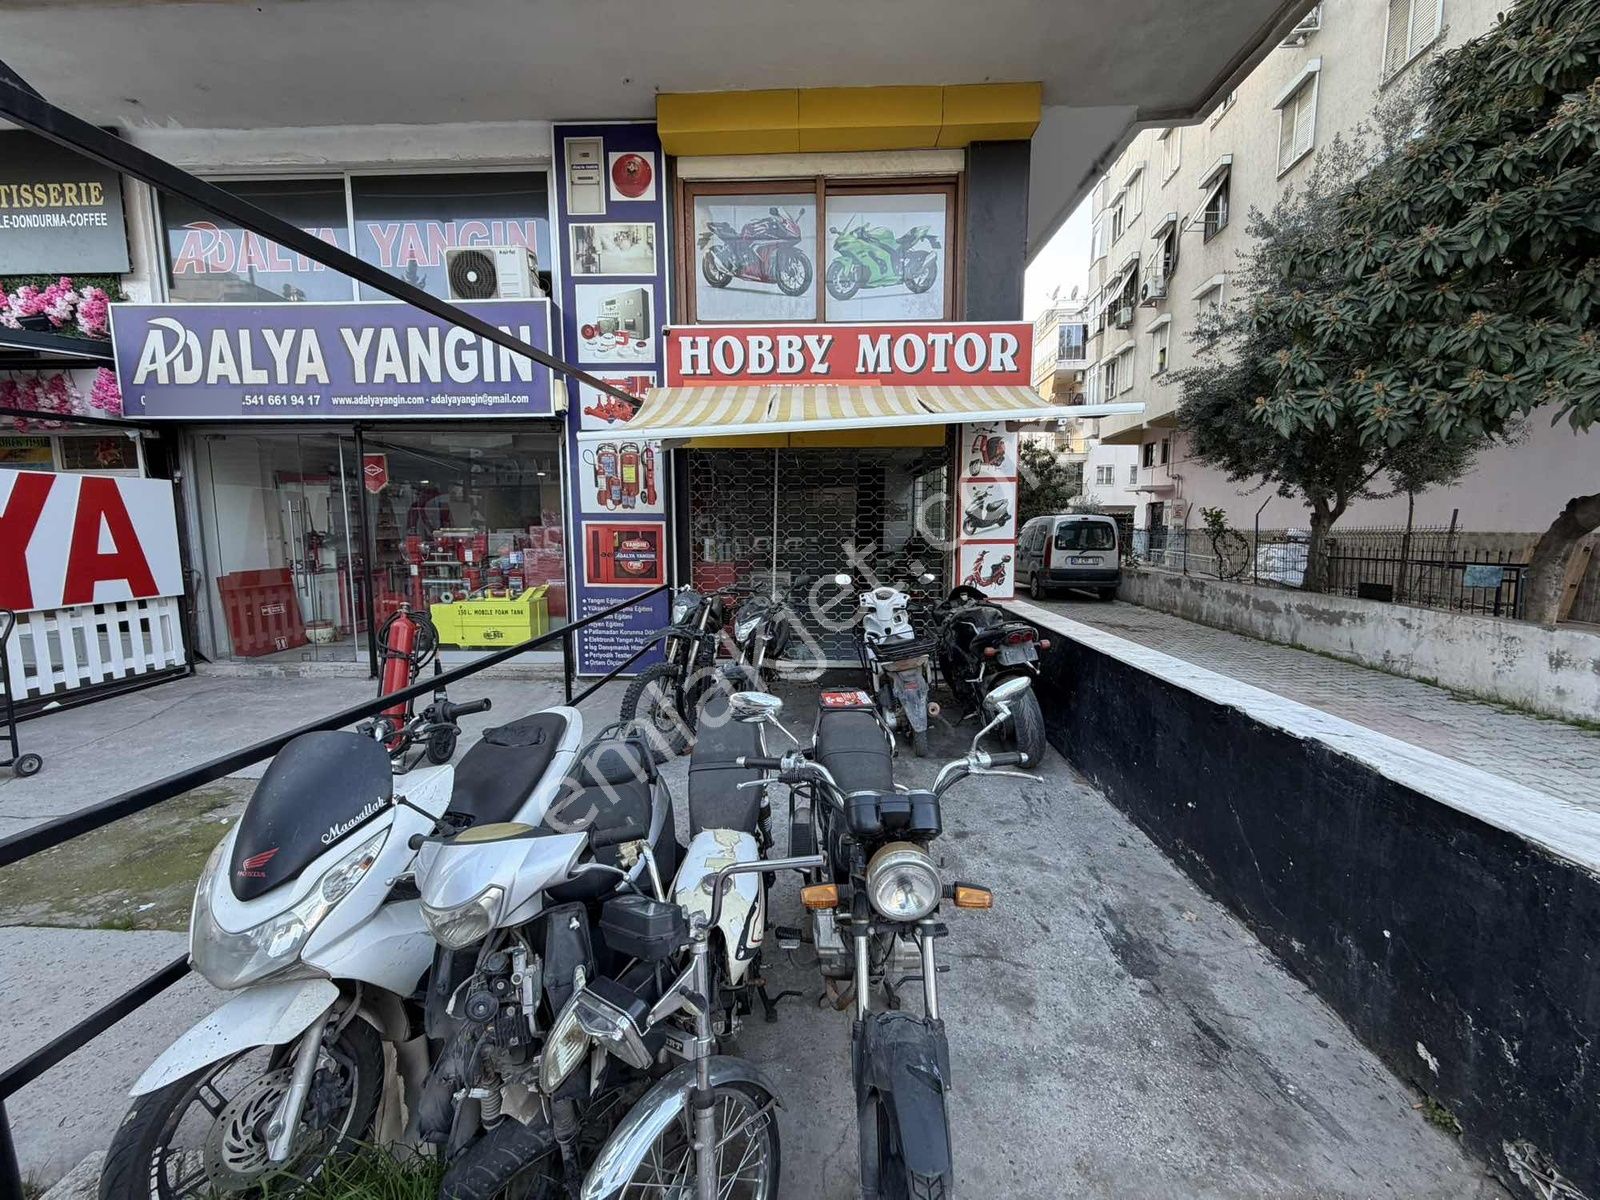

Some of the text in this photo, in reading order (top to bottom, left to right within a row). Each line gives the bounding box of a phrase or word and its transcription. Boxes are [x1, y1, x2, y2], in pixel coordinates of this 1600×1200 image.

[0, 182, 104, 208] TISSERIE
[133, 317, 533, 384] ADALYA YANGIN
[679, 331, 1019, 375] HOBBY MOTOR
[267, 395, 287, 406] 661
[290, 395, 304, 405] 94
[307, 395, 320, 405] 17
